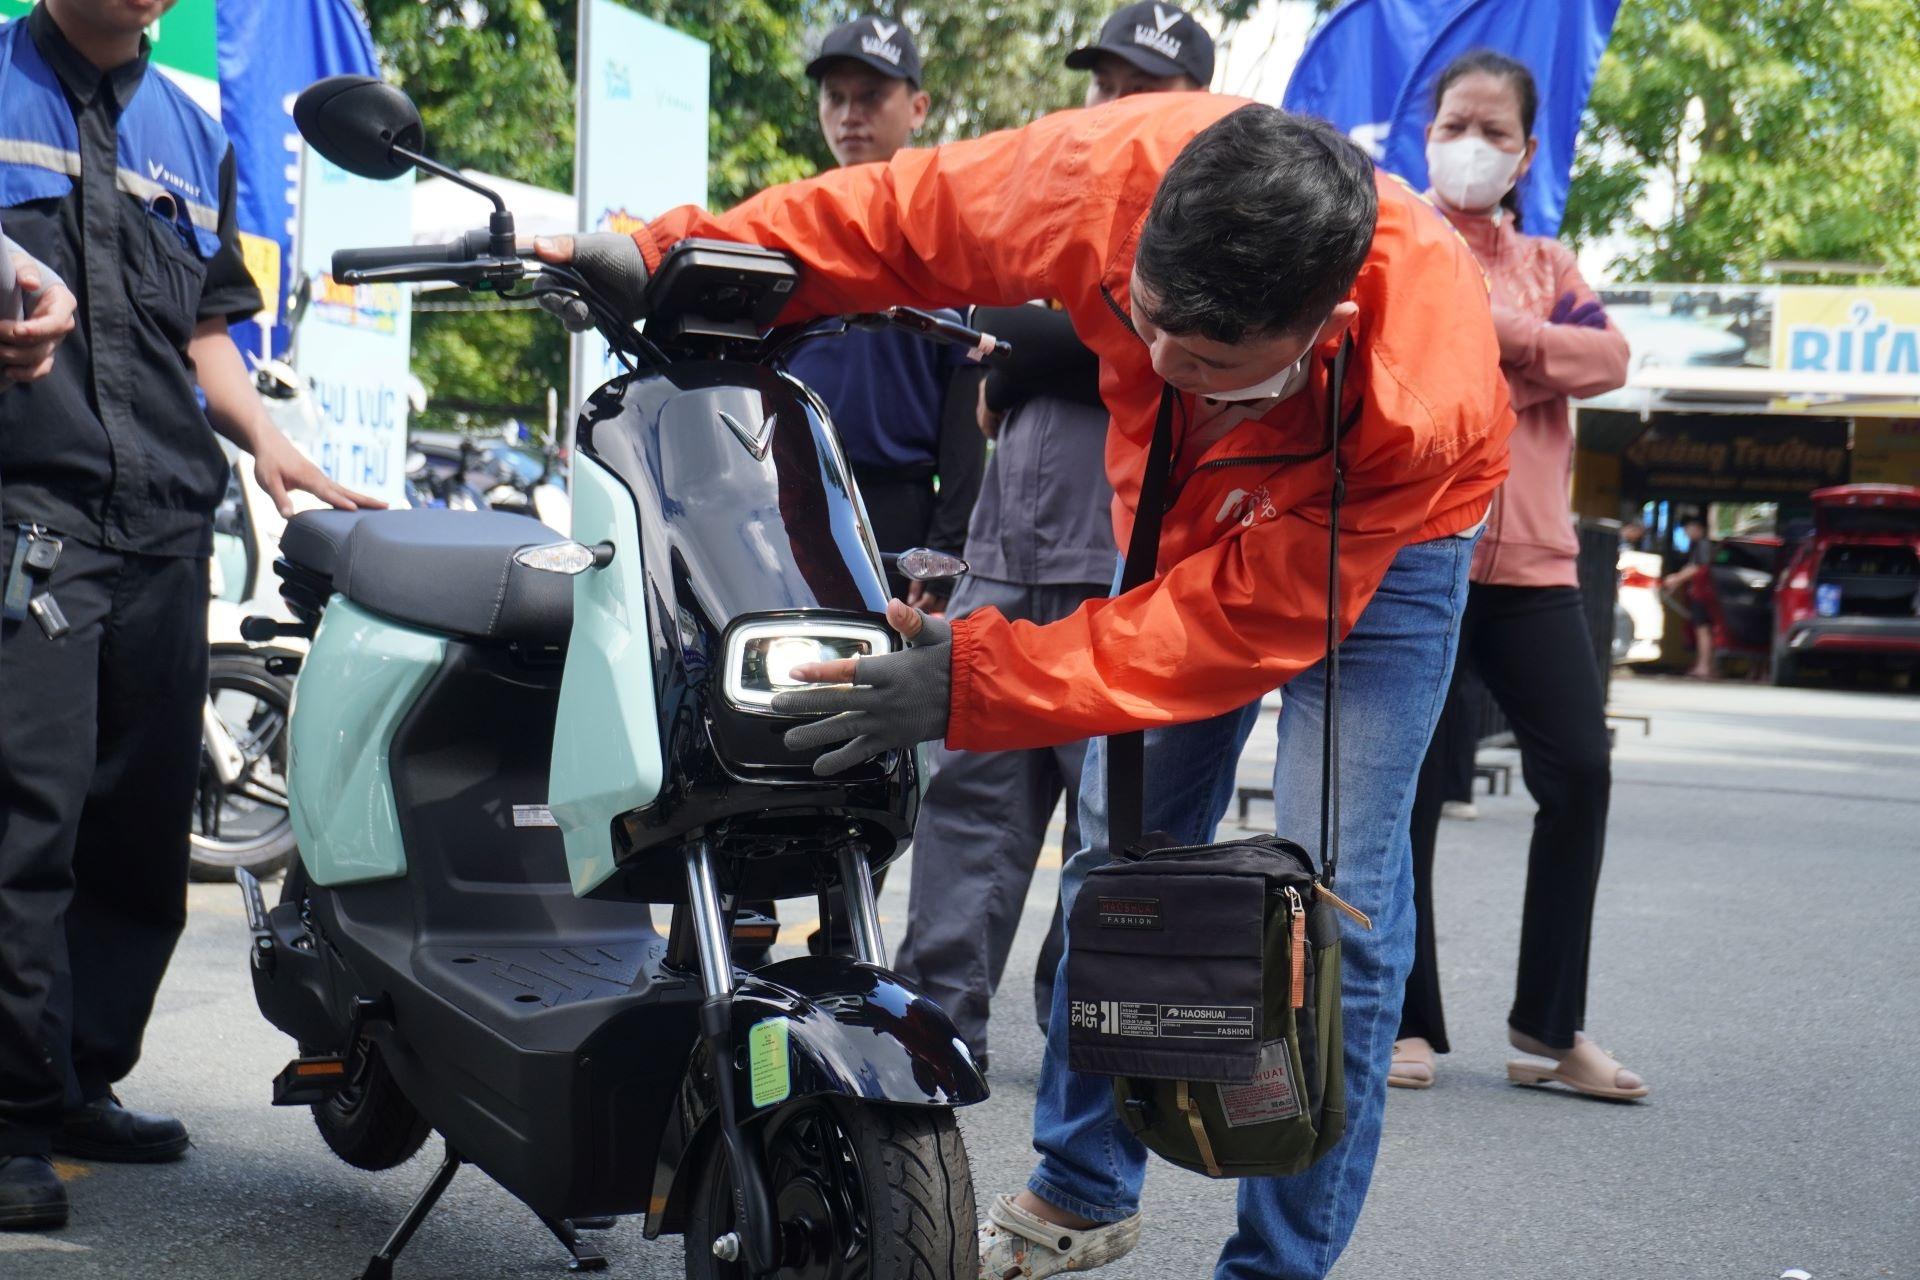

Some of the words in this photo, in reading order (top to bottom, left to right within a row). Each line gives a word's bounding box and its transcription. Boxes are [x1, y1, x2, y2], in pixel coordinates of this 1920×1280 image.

[1107, 916, 1152, 926] FASHION
[1071, 1000, 1082, 1027] H.S.
[1084, 1002, 1098, 1029] 95
[1180, 1008, 1227, 1019] HAOSHUAI
[1217, 1027, 1250, 1036] FASHION
[1251, 1067, 1284, 1081] HUAI
